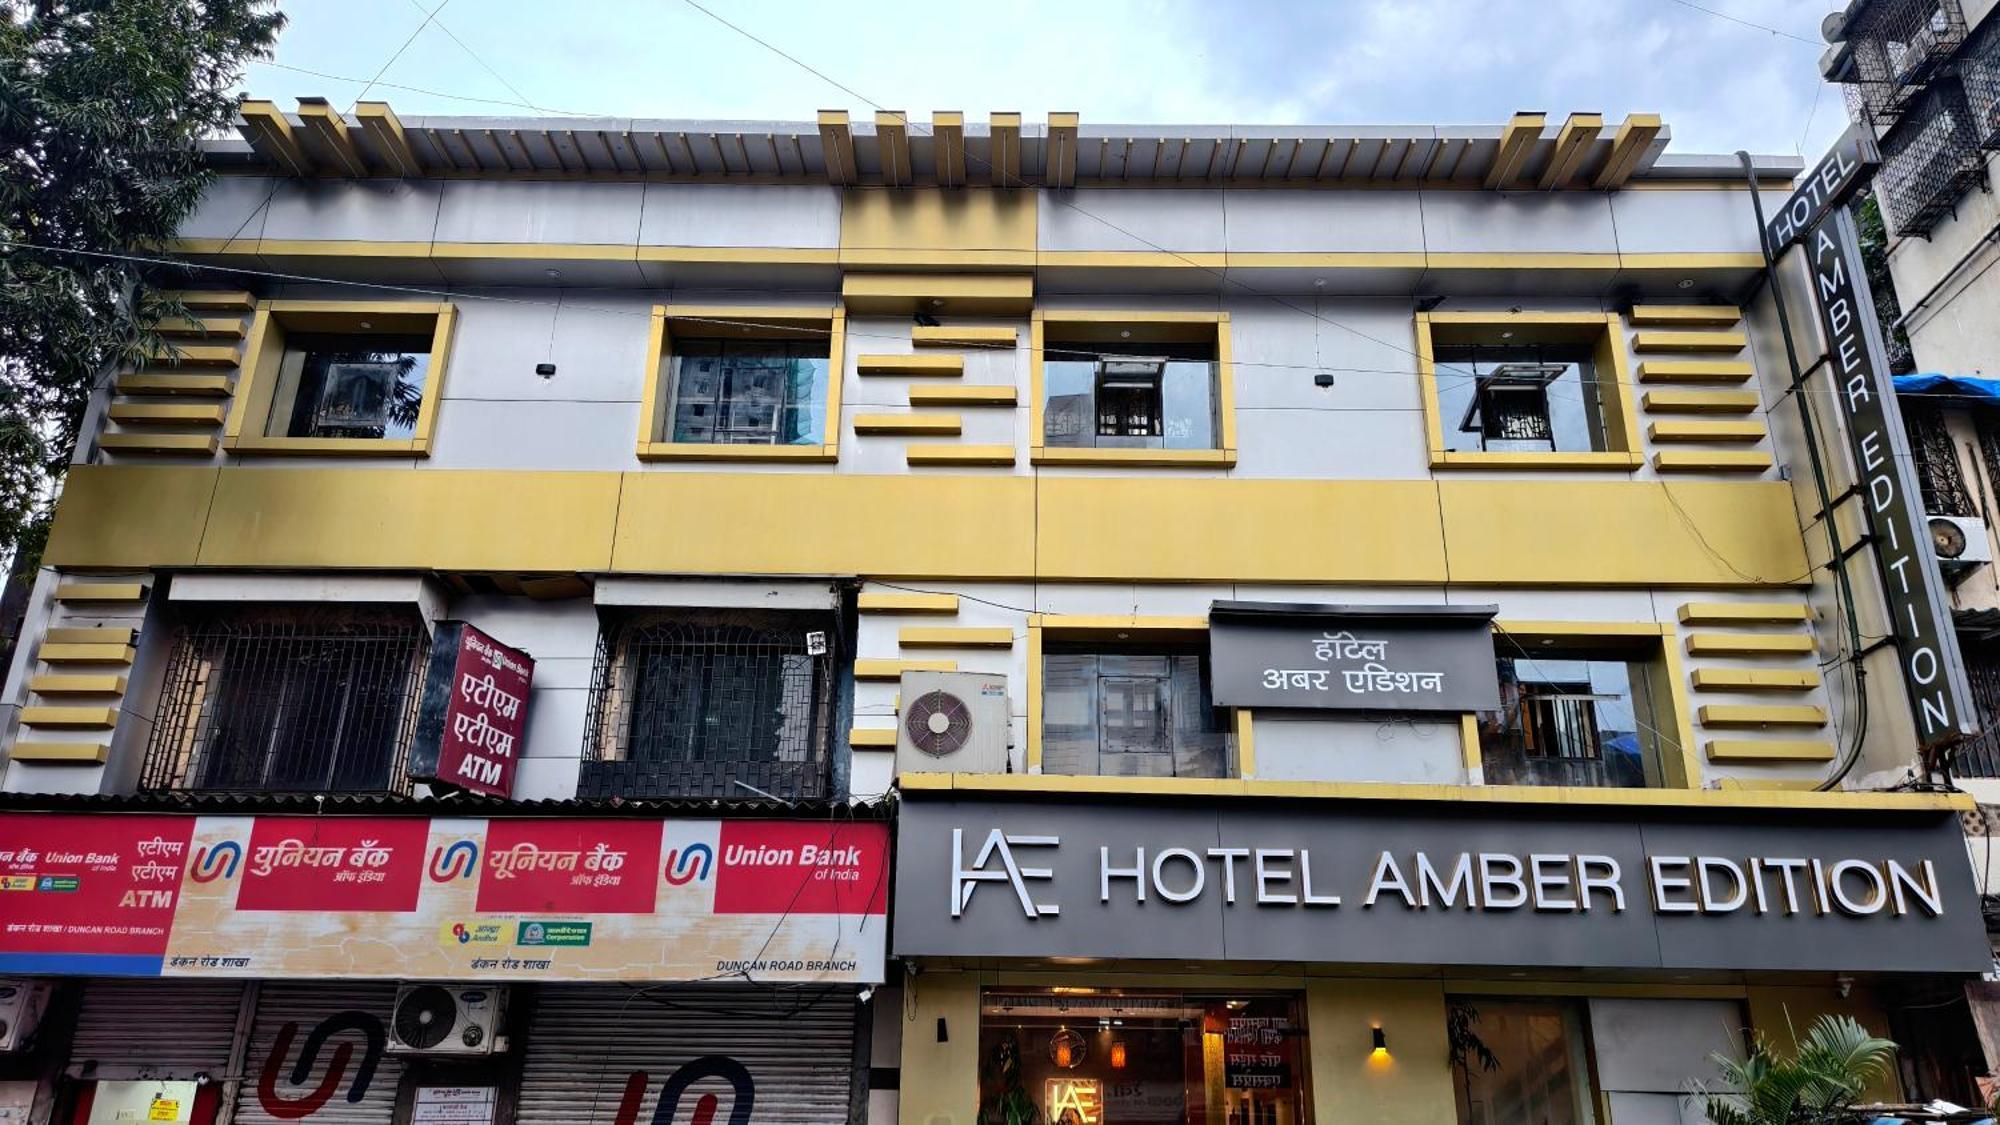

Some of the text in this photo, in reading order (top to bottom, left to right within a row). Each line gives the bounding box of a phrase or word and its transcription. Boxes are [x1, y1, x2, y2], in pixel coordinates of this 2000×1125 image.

[1775, 151, 1856, 247] HOTEL
[1816, 228, 1949, 734] AMBER EDITION
[1312, 631, 1389, 661] हॉटेल
[1262, 662, 1445, 694] अबर एडिशन
[460, 674, 522, 721] एटीएम
[453, 712, 515, 758] एटीएम
[457, 753, 502, 786] ATM
[45, 851, 119, 865] Union Bank
[137, 836, 184, 858] एटीएम
[250, 839, 394, 876] युनियन बँक
[725, 844, 863, 867] Union Bank
[131, 860, 179, 882] एटीएम
[489, 843, 627, 880] यूनियन बैंक
[357, 869, 387, 883] इंडिया
[593, 874, 621, 888] इंडिया
[815, 868, 860, 881] of India
[1100, 846, 1944, 917] HOTEL AMBER EDITION
[118, 889, 173, 908] ATM
[67, 925, 102, 934] DUNCAN
[103, 926, 128, 935] ROAD
[129, 927, 164, 936] BRANCH
[170, 953, 250, 967] डंकन रोड शाखा
[471, 956, 551, 970] डंकन रोड शाखा
[716, 960, 856, 971] DUNCAN ROAD BRANCH
